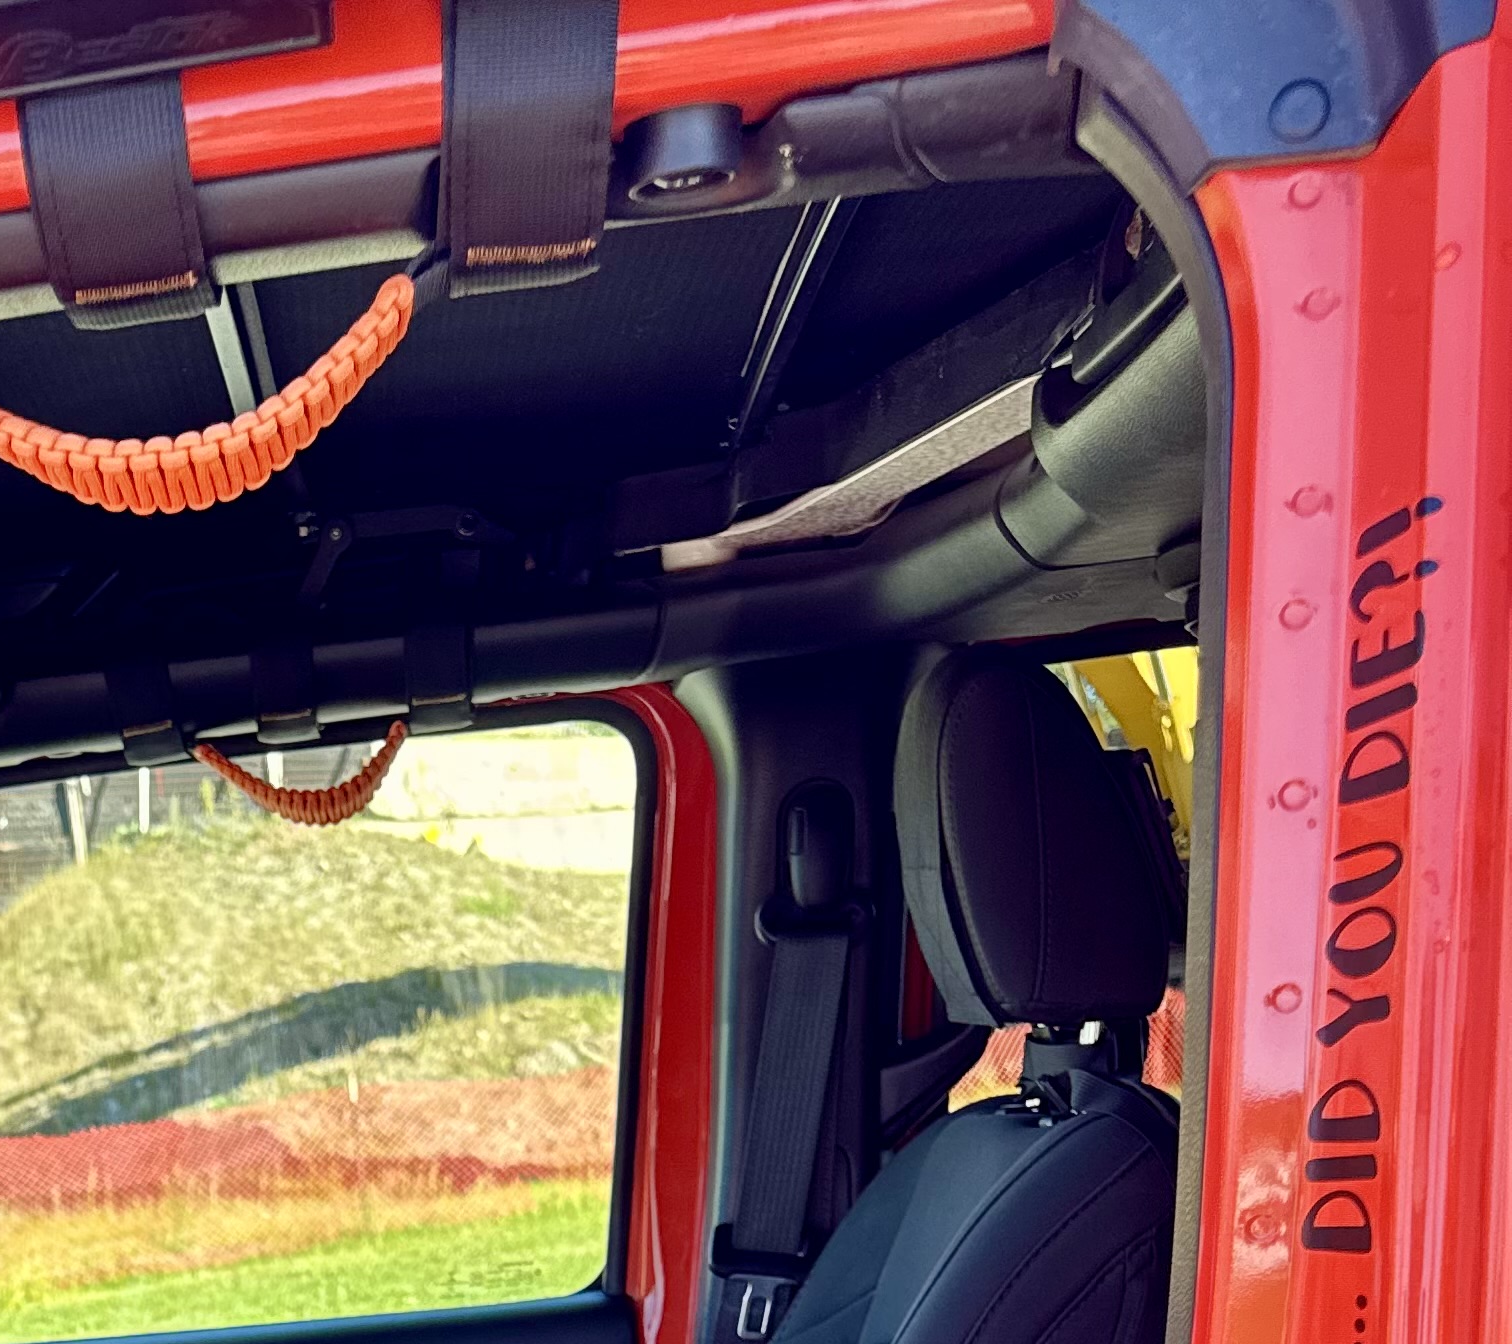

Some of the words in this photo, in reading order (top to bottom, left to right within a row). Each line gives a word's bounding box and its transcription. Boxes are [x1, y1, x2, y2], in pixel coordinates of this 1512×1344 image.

[1338, 496, 1444, 806] DIE?!
[1316, 841, 1403, 1048] YOU
[1301, 1079, 1381, 1254] DID
